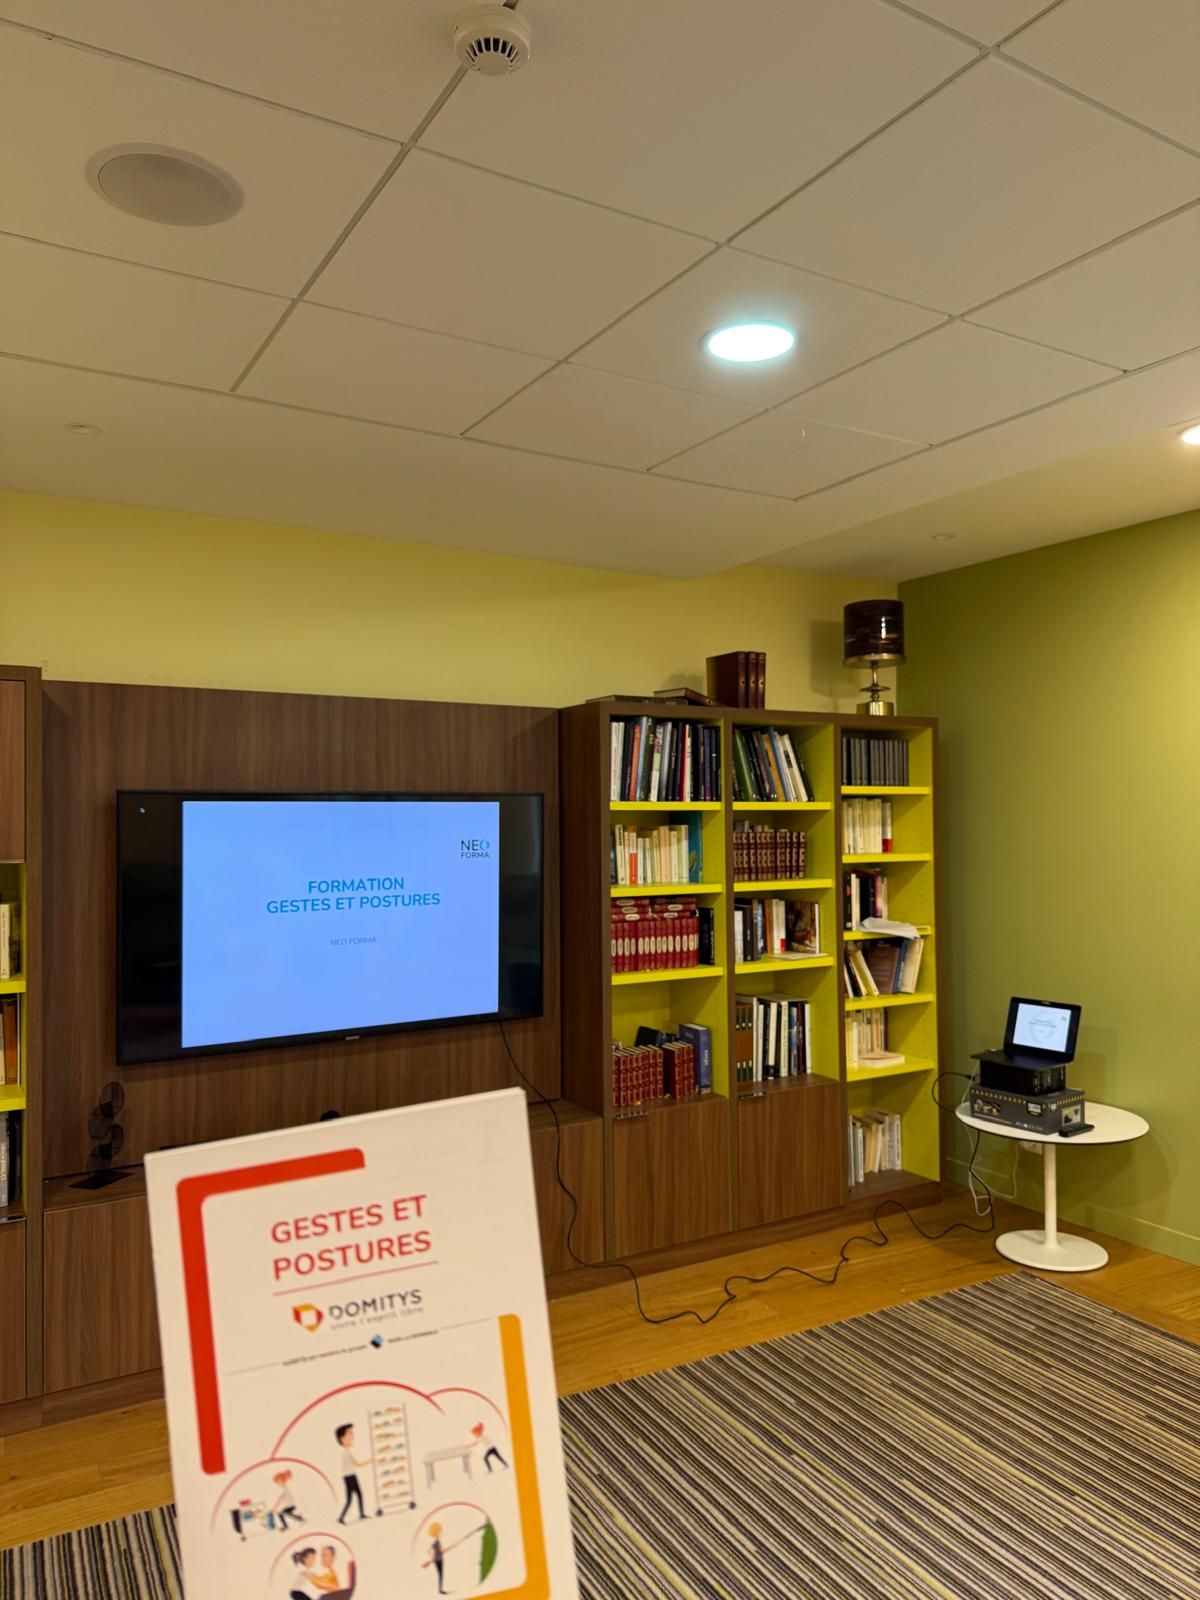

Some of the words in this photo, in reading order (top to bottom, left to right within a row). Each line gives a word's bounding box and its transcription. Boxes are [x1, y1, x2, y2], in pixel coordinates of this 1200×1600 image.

[460, 839, 490, 851] NEO
[460, 851, 490, 859] FORMA
[308, 877, 404, 894] FORMATION
[266, 898, 331, 914] GESTES
[335, 896, 355, 910] ET
[359, 893, 441, 910] POSTURES
[330, 938, 347, 946] NEO
[348, 936, 377, 945] FORMA
[271, 1204, 383, 1244] GESTES
[393, 1195, 427, 1221] ET
[273, 1231, 432, 1281] POSTURES
[328, 1289, 422, 1320] DOMITYS
